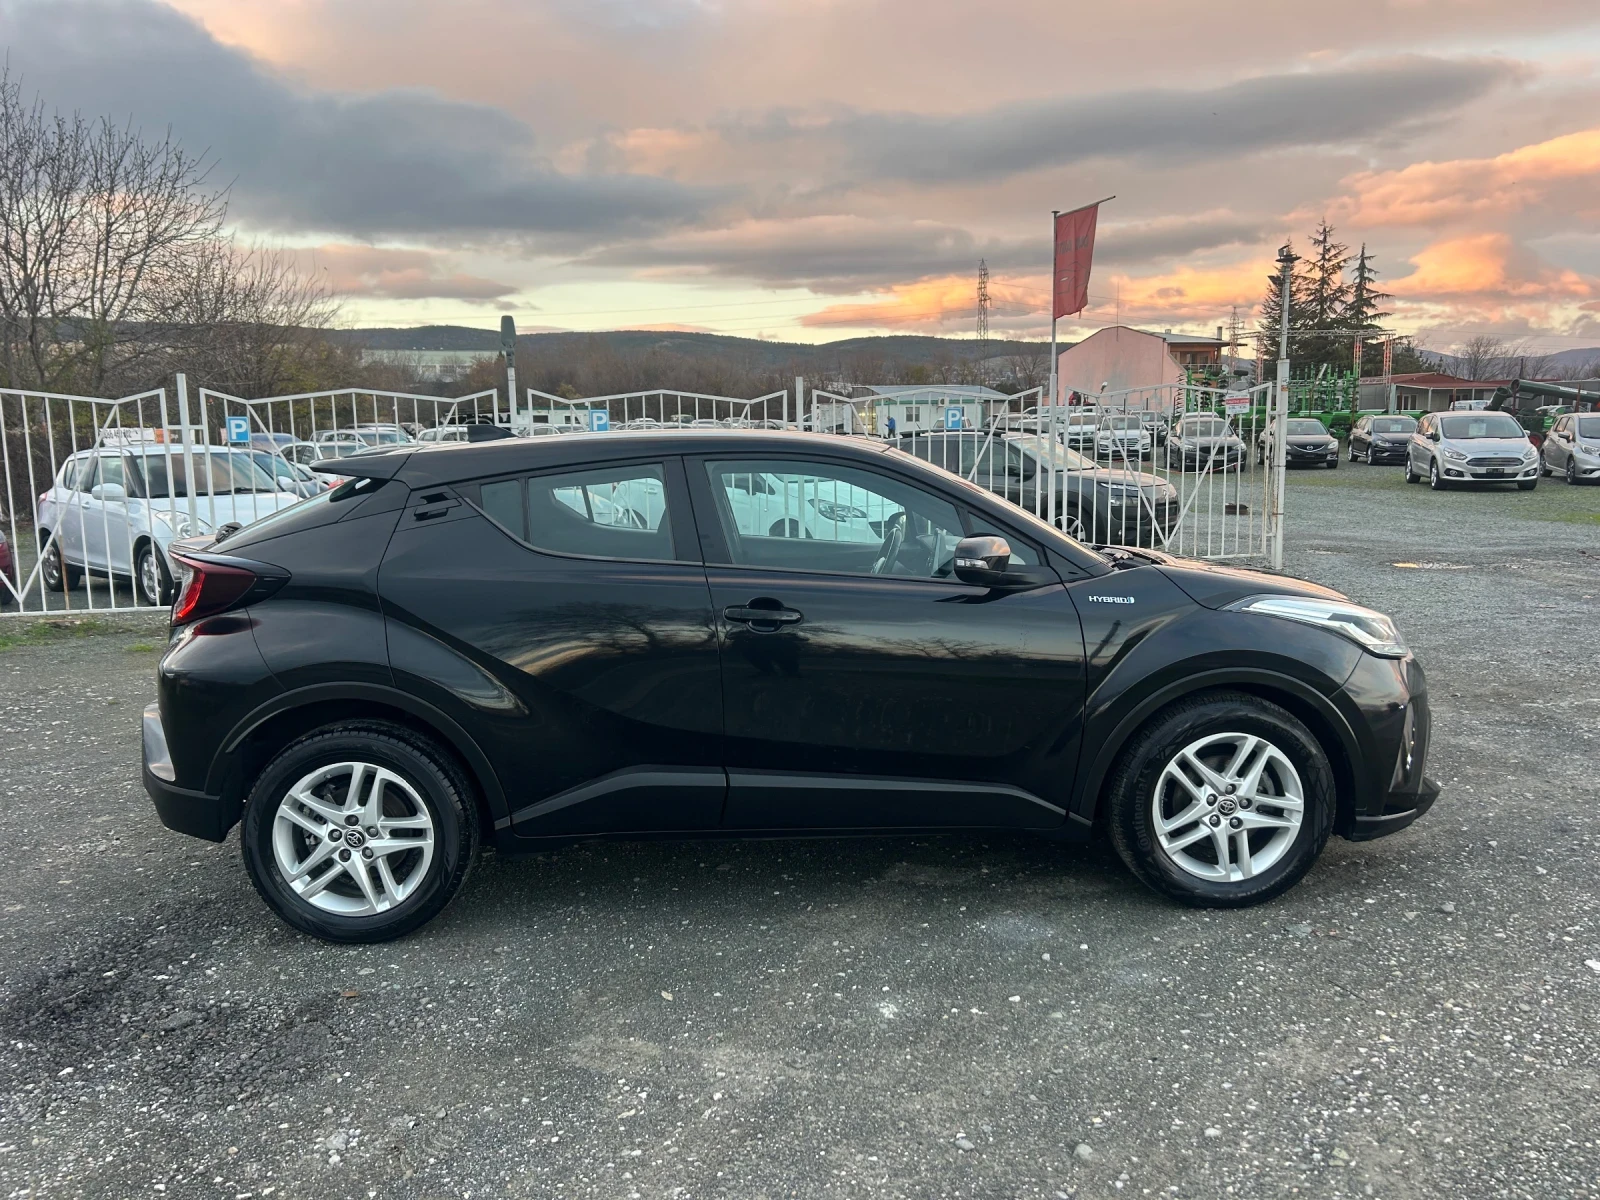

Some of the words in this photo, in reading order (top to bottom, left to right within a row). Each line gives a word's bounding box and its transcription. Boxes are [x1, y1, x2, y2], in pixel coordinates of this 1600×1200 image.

[593, 412, 607, 430] P
[948, 410, 961, 428] P
[230, 420, 247, 440] P
[1088, 595, 1127, 604] HYBRID
[1131, 775, 1154, 852] Continental
